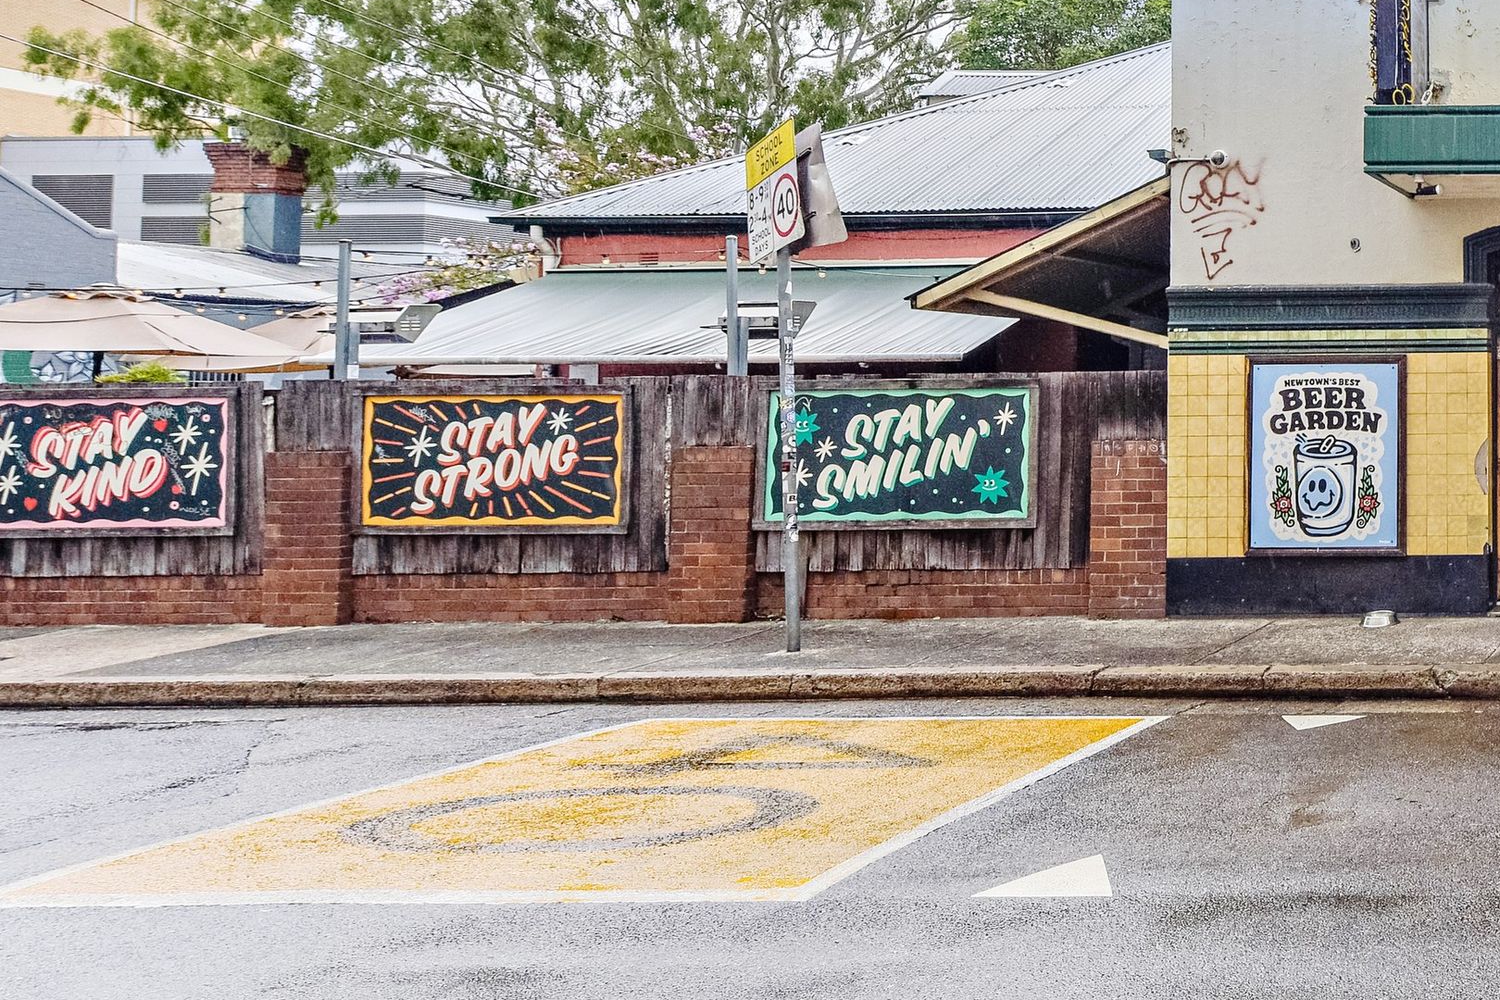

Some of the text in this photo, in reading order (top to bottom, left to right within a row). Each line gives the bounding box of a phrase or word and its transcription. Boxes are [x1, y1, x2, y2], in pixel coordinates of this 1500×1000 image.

[755, 136, 783, 162] SCHOOL
[760, 152, 779, 176] ZONE
[777, 188, 795, 218] 40
[752, 228, 771, 246] SCHOOL
[754, 240, 769, 256] DAYS
[1284, 378, 1361, 387] NEWTOWN'S BEST
[1278, 387, 1367, 412] BEER
[437, 403, 548, 466] STAY
[841, 397, 956, 460] STAY
[1270, 410, 1382, 435] GARDEN
[28, 407, 149, 479] STAY
[411, 434, 579, 515] STRONG
[812, 419, 991, 511] SMILIN'
[49, 448, 168, 519] KIND
